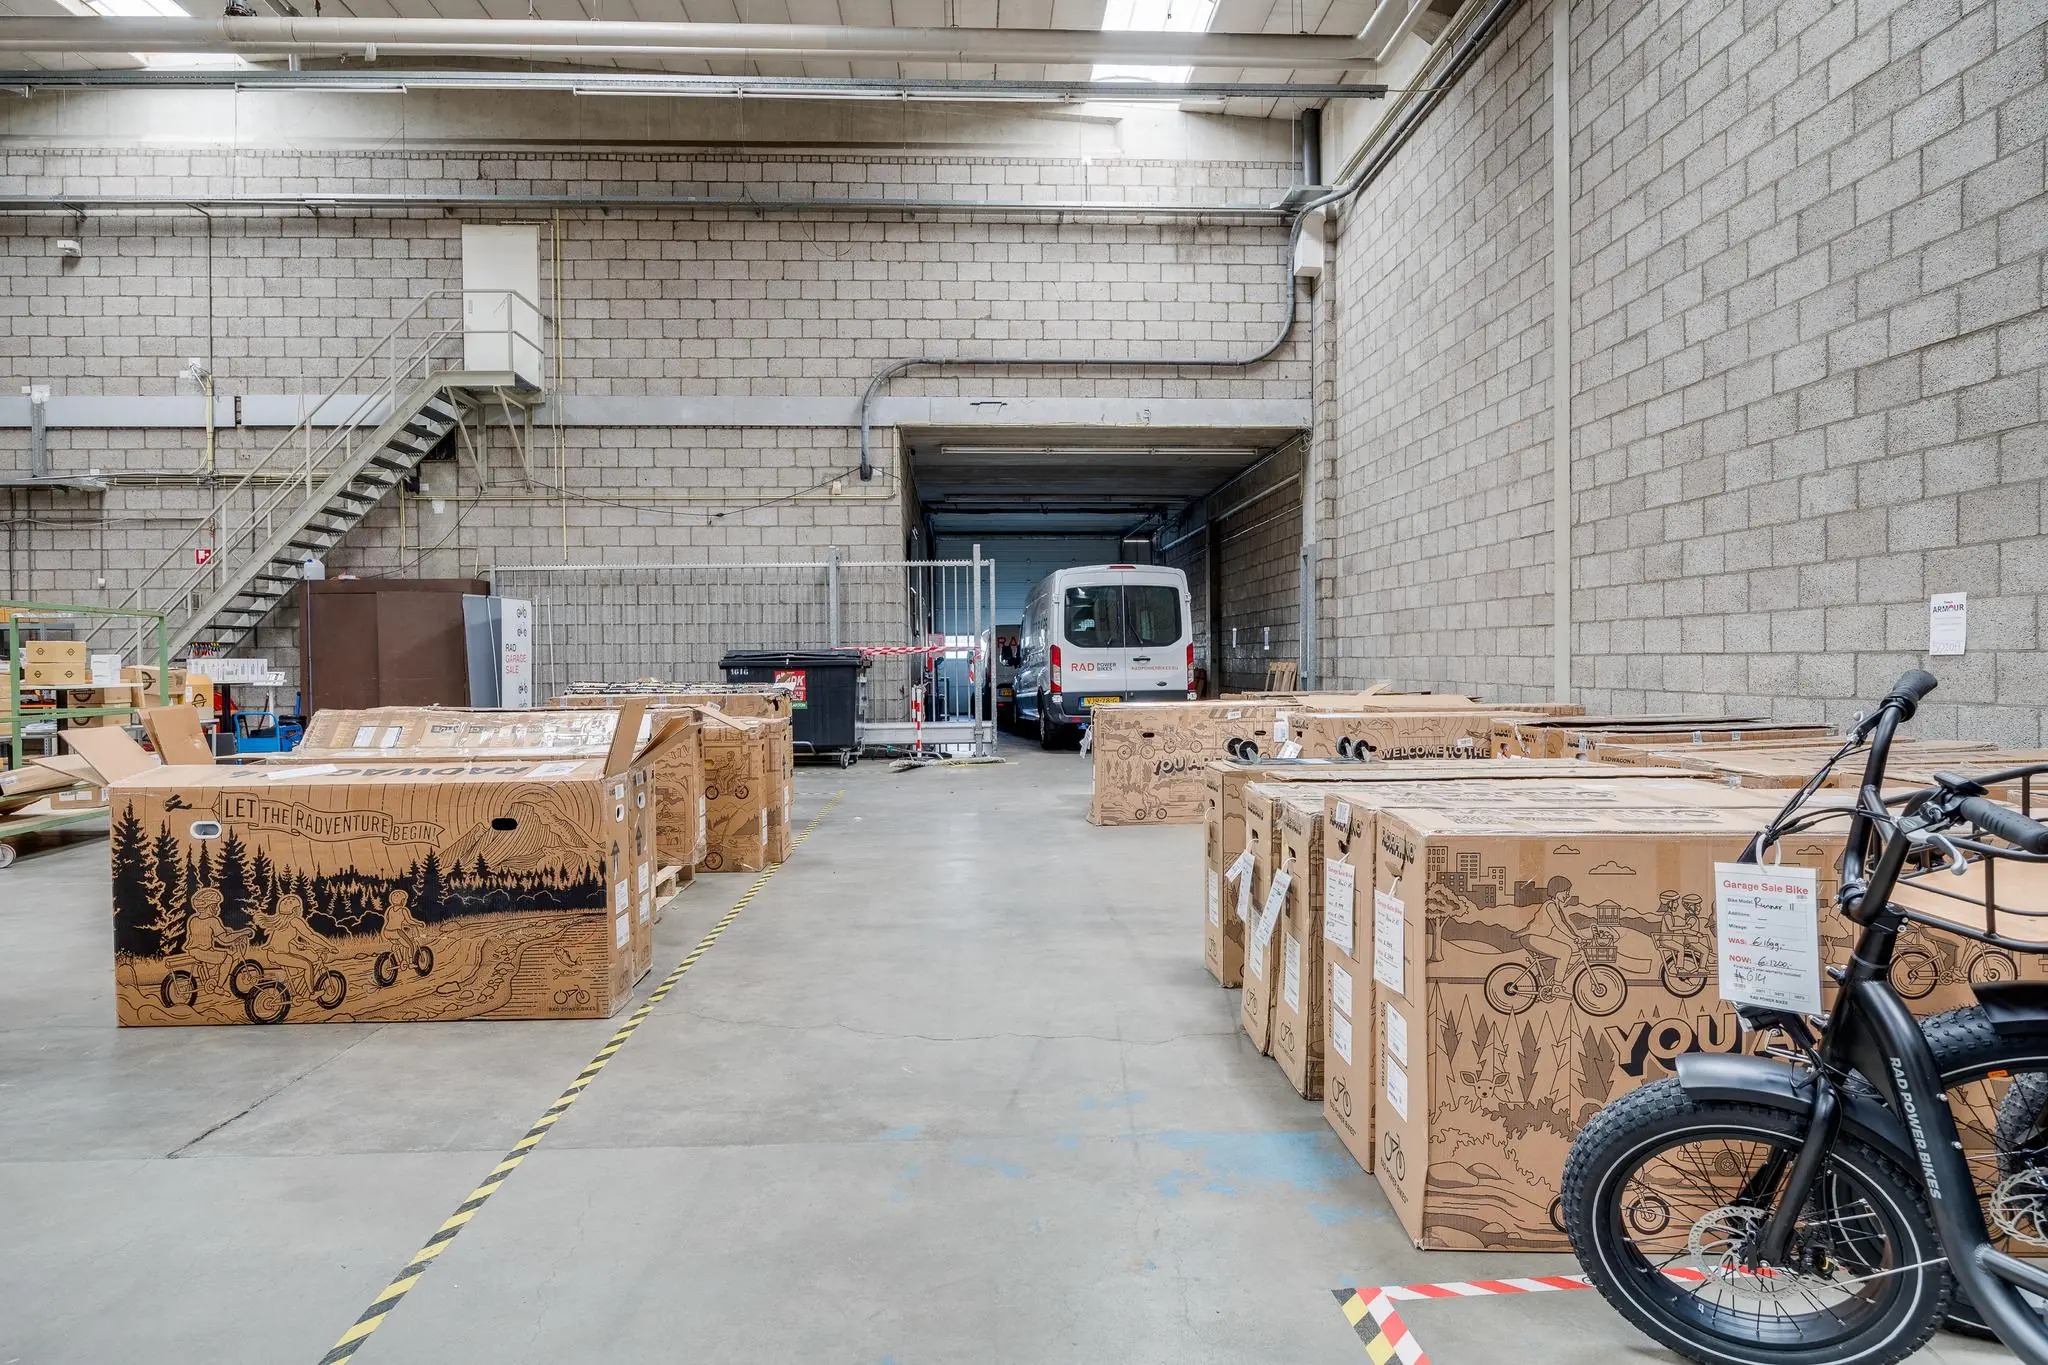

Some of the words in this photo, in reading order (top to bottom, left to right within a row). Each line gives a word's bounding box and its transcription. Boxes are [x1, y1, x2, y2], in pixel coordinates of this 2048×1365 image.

[1932, 604, 1964, 613] ARMOUR
[506, 643, 516, 652] RAD
[998, 636, 1017, 648] RA
[505, 654, 527, 663] GARAGE
[505, 665, 519, 674] SALE
[1071, 662, 1095, 672] RAD
[1380, 745, 1444, 760] WELCOME
[1446, 746, 1463, 759] TO
[1466, 746, 1491, 760] THE
[262, 764, 531, 778] RADWAG
[1152, 757, 1186, 776] YOU
[225, 798, 256, 818] LET
[262, 806, 290, 826] THE
[296, 809, 388, 836] RADVENTURE
[392, 824, 438, 842] BEGIN!
[1723, 880, 1758, 892] Garage
[1761, 884, 1783, 892] Sale
[1785, 885, 1809, 895] Bike
[1728, 937, 1747, 945] WAS:
[1729, 954, 1751, 964] NOW:
[1604, 1012, 1746, 1077] YOU
[1890, 1057, 1908, 1092] RAD
[1902, 1092, 1927, 1149] POWER
[1918, 1151, 1942, 1200] BIKES
